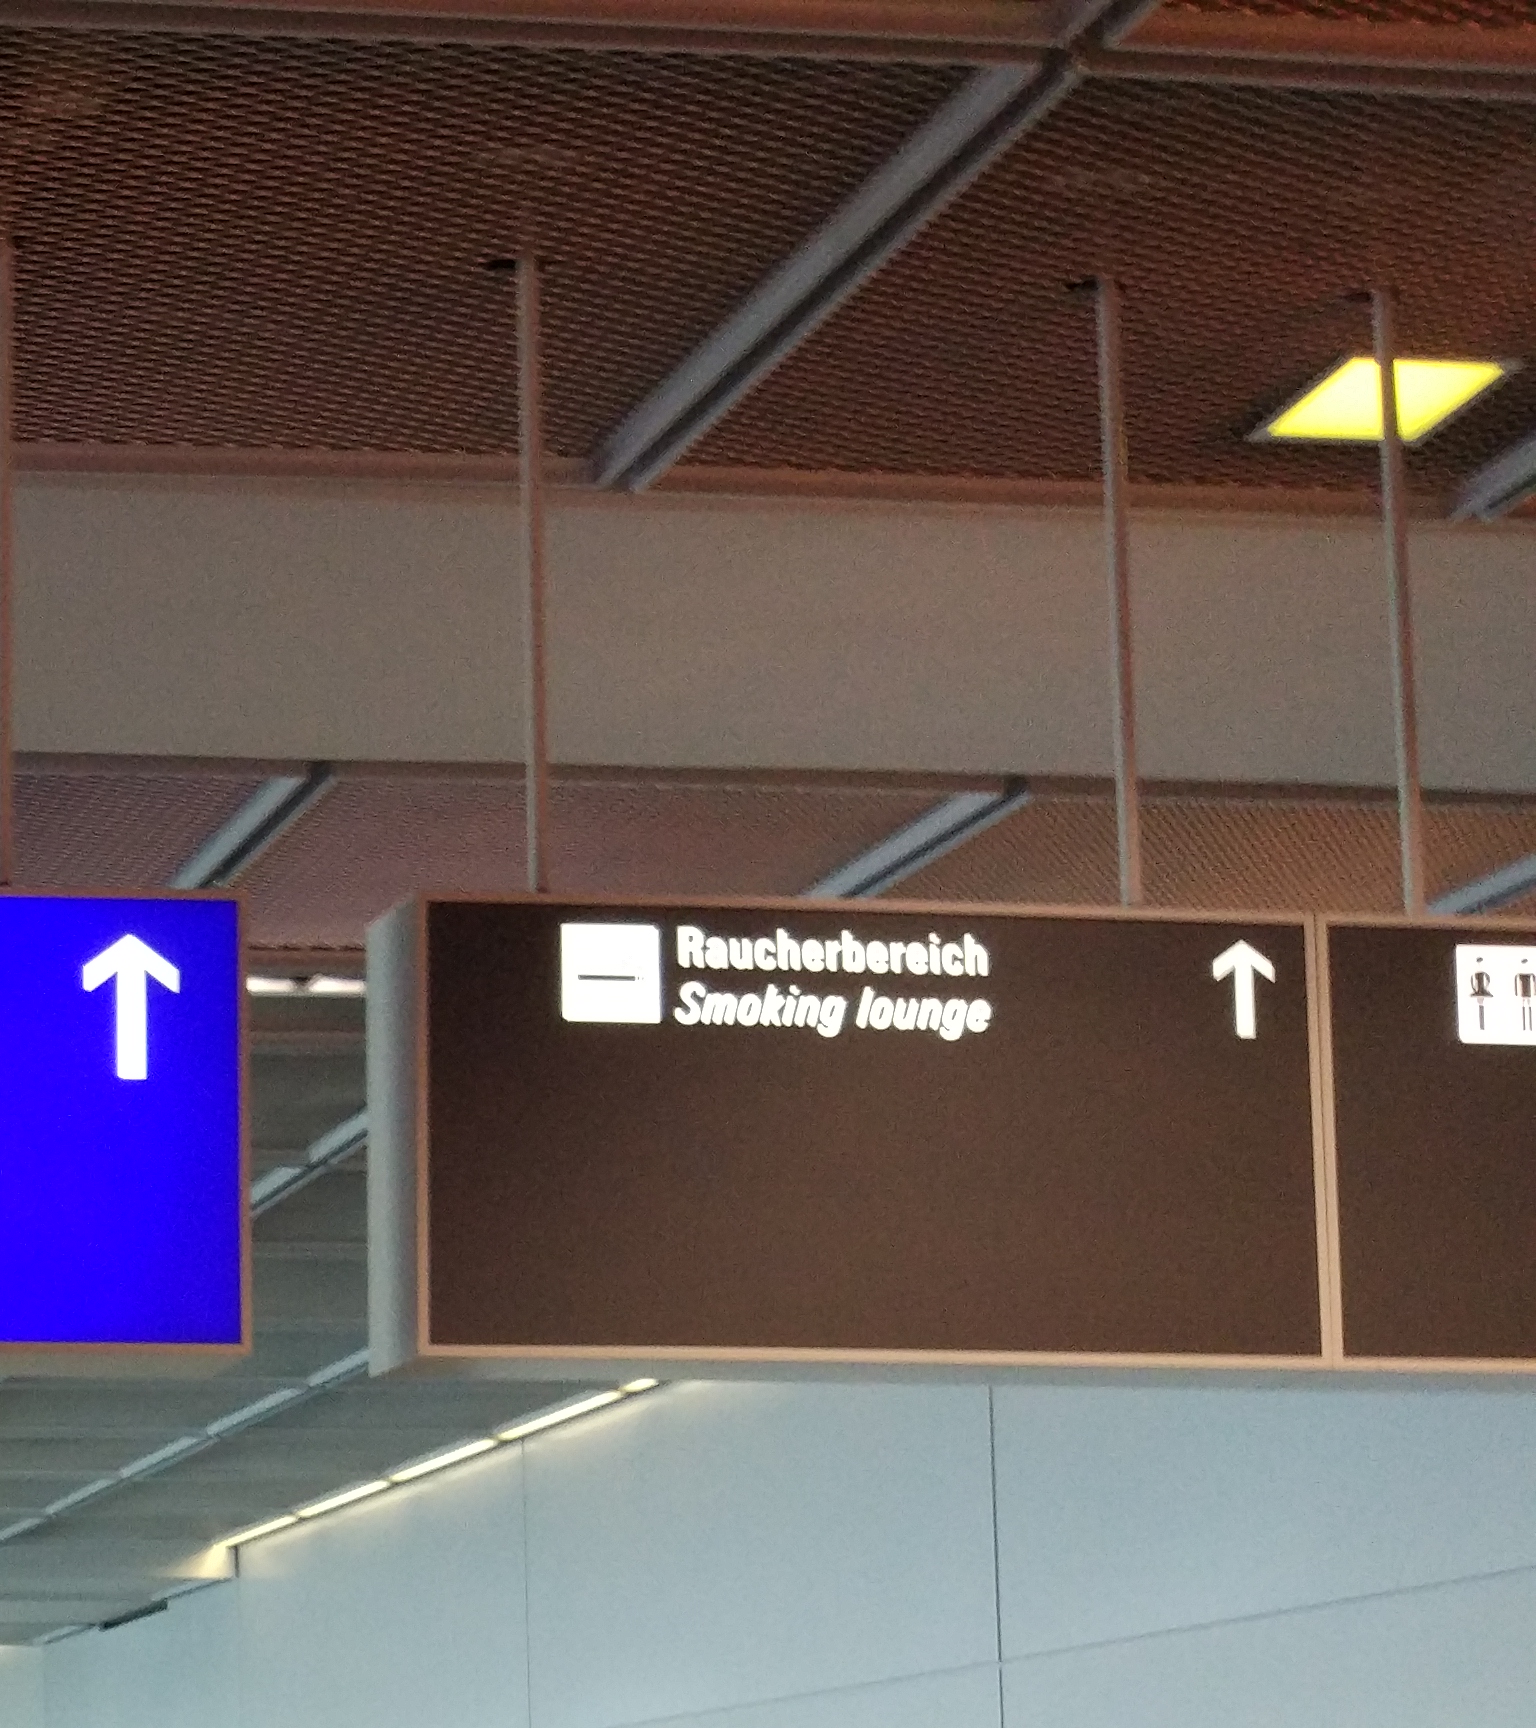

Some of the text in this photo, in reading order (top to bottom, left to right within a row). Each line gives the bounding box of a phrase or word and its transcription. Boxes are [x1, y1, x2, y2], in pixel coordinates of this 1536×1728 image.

[676, 924, 991, 977] Raucherbereich
[674, 980, 993, 1042] Smoking lounge
